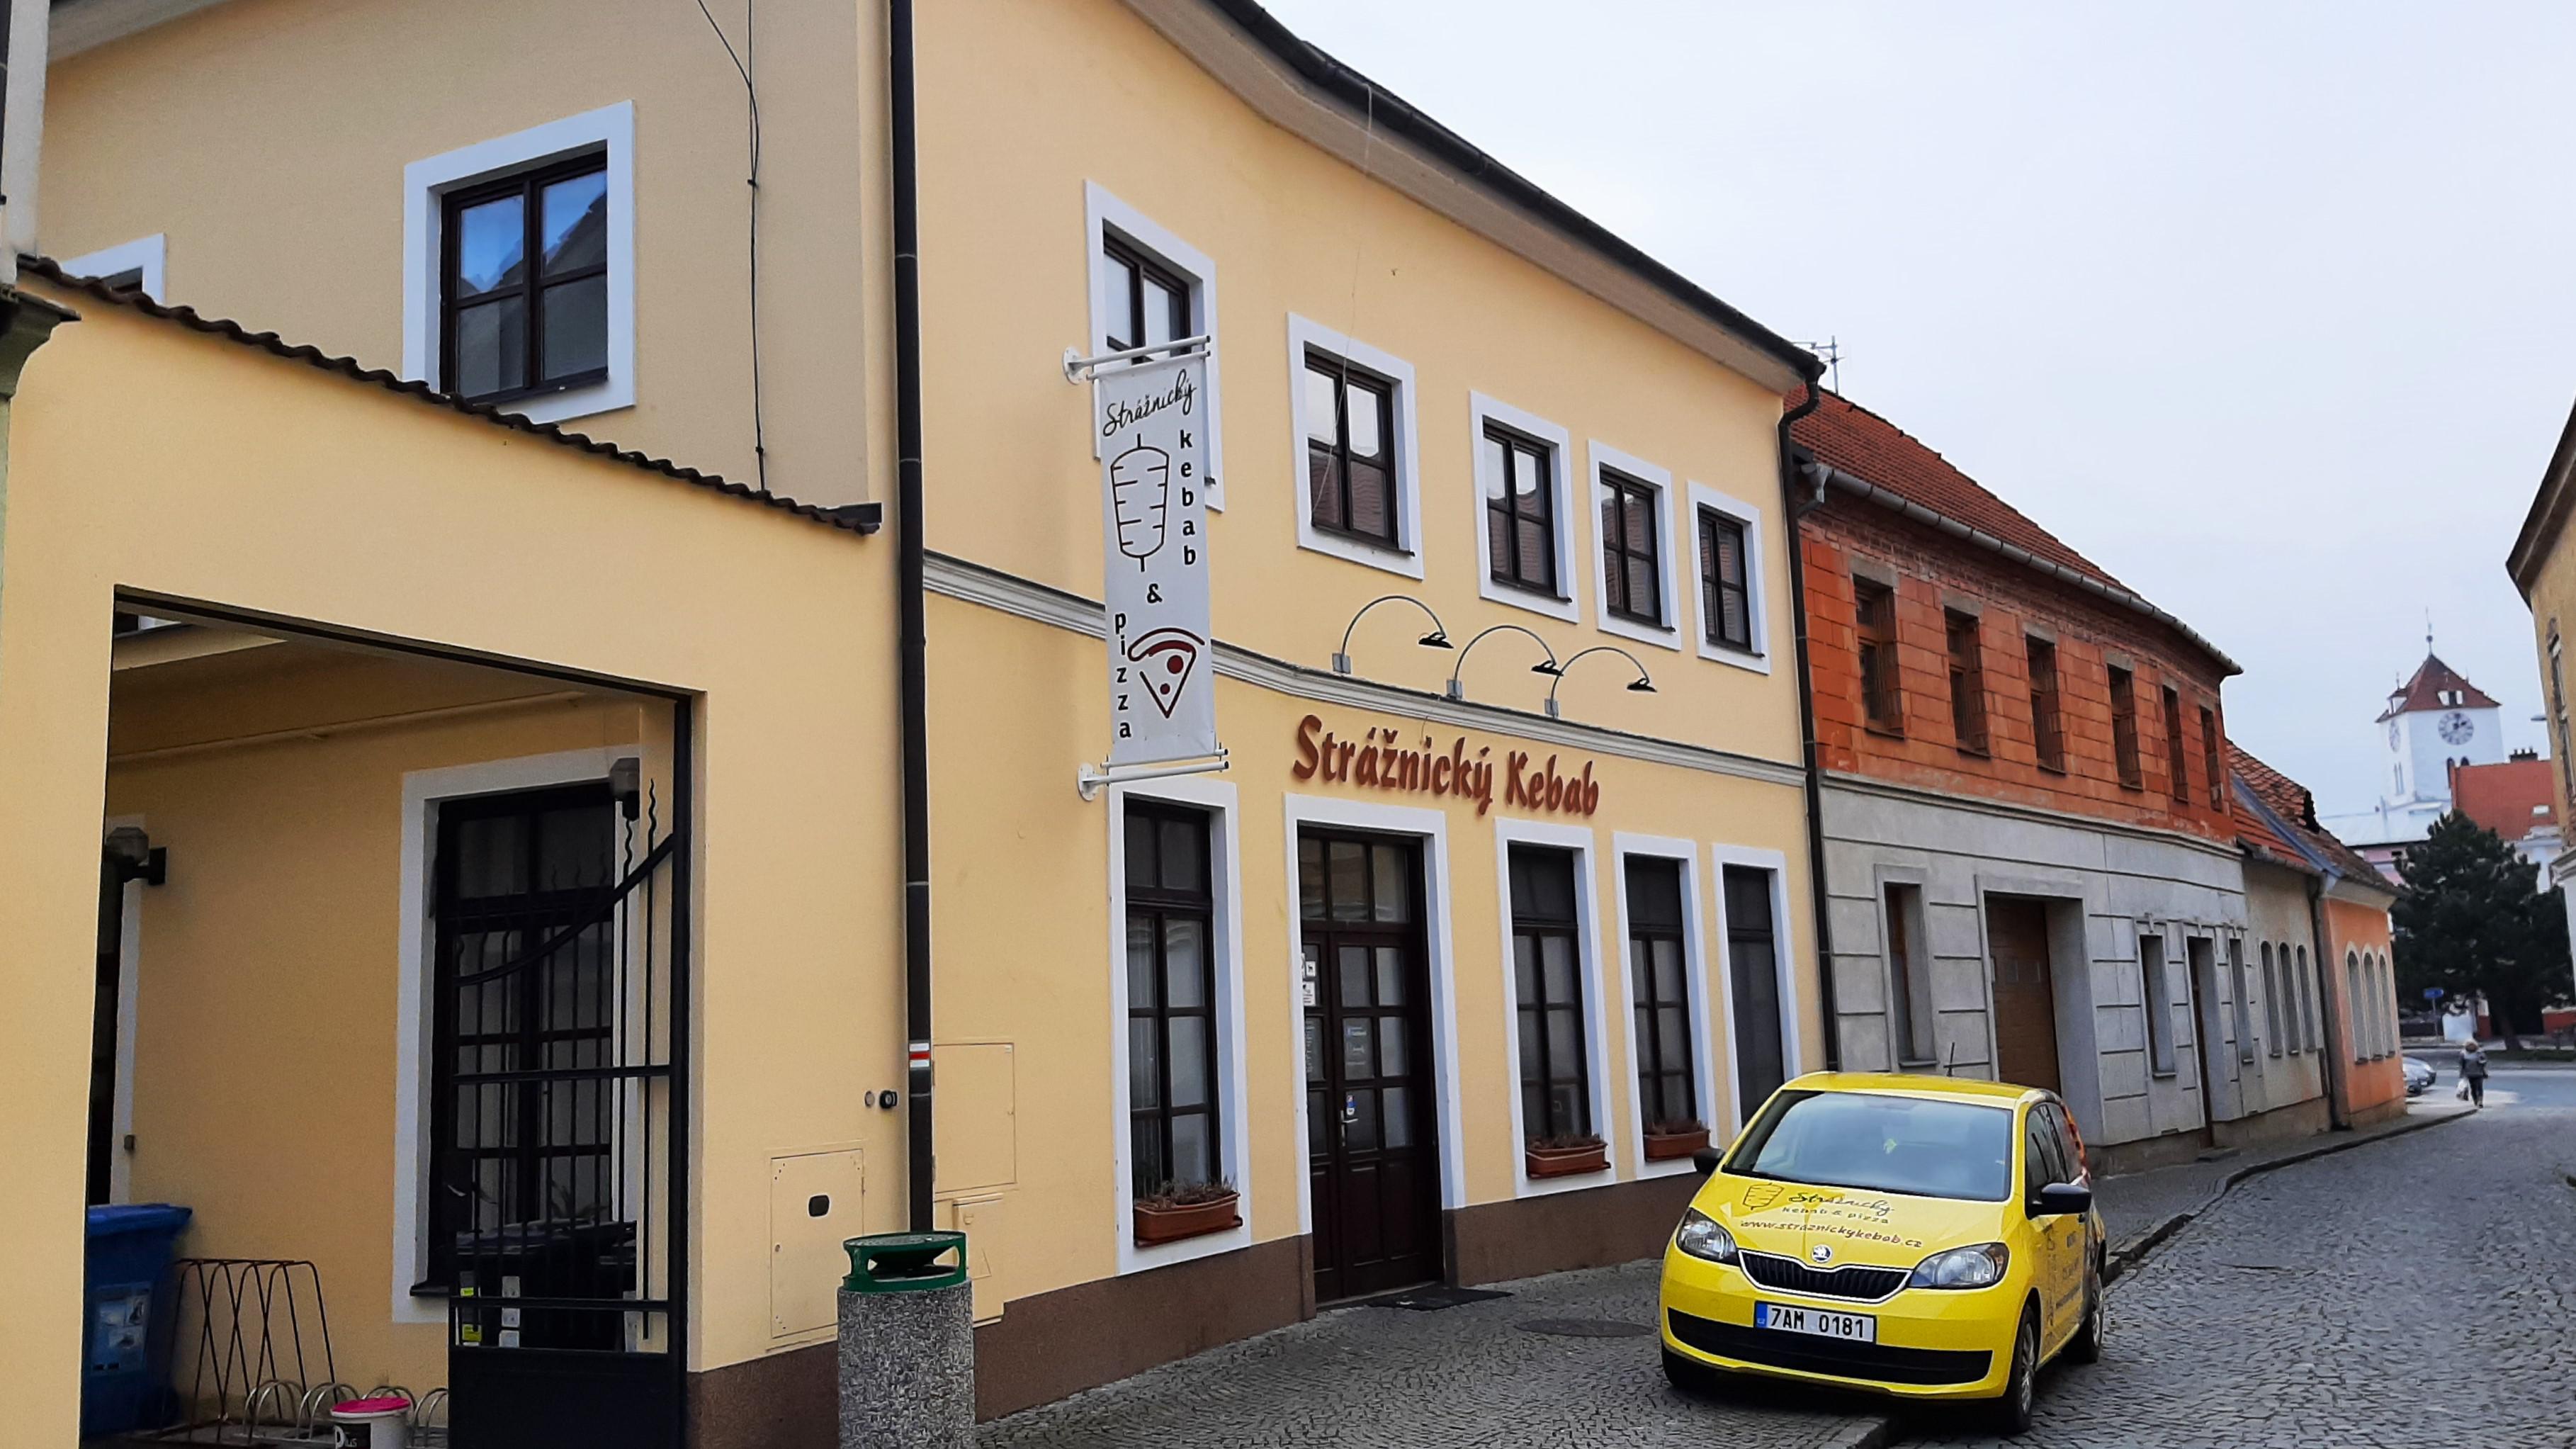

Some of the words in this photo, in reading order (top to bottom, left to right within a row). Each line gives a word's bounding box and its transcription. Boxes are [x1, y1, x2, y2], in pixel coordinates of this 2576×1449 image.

[1103, 368, 1197, 437] Strážnický
[1180, 429, 1197, 566] kebab
[1146, 582, 1163, 604] &
[1114, 611, 1131, 740] pizza
[1293, 714, 1493, 815] Strážnický
[1507, 750, 1599, 816] Kebab
[1847, 1212, 1889, 1224] pizza
[1771, 1308, 1804, 1330] 7AM
[1819, 1314, 1864, 1338] 0181
